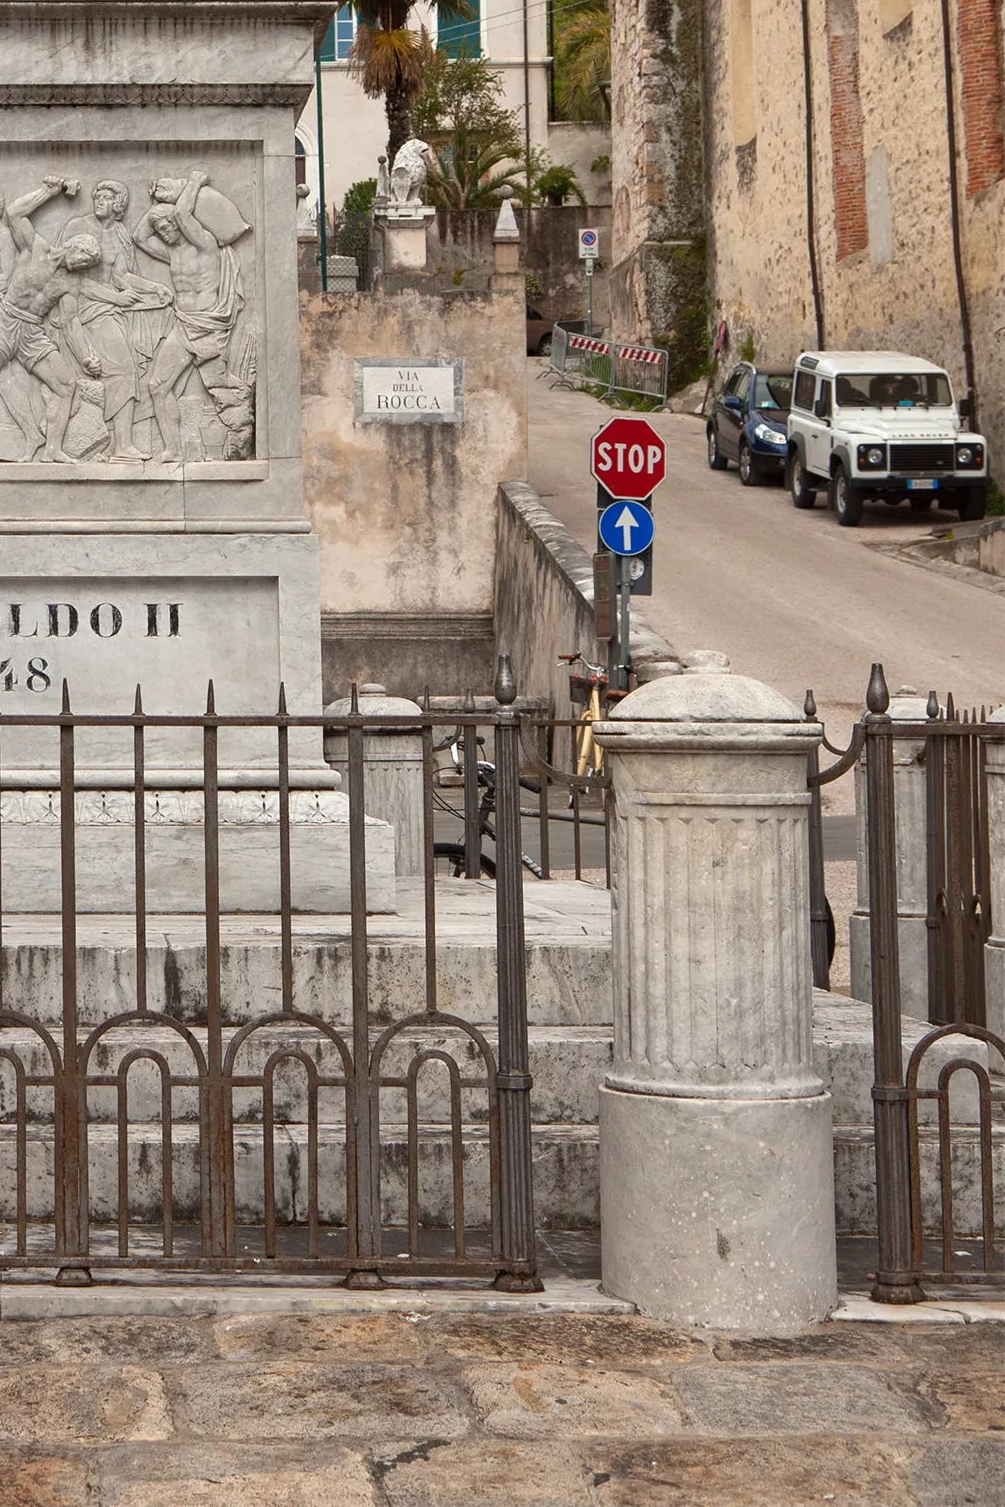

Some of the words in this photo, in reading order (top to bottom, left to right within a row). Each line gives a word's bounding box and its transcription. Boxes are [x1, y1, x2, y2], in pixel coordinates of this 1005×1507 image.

[398, 370, 419, 381] VIA
[393, 384, 423, 392] DELLA
[377, 395, 441, 409] ROCCA
[597, 442, 662, 474] STOP
[143, 602, 185, 638] II
